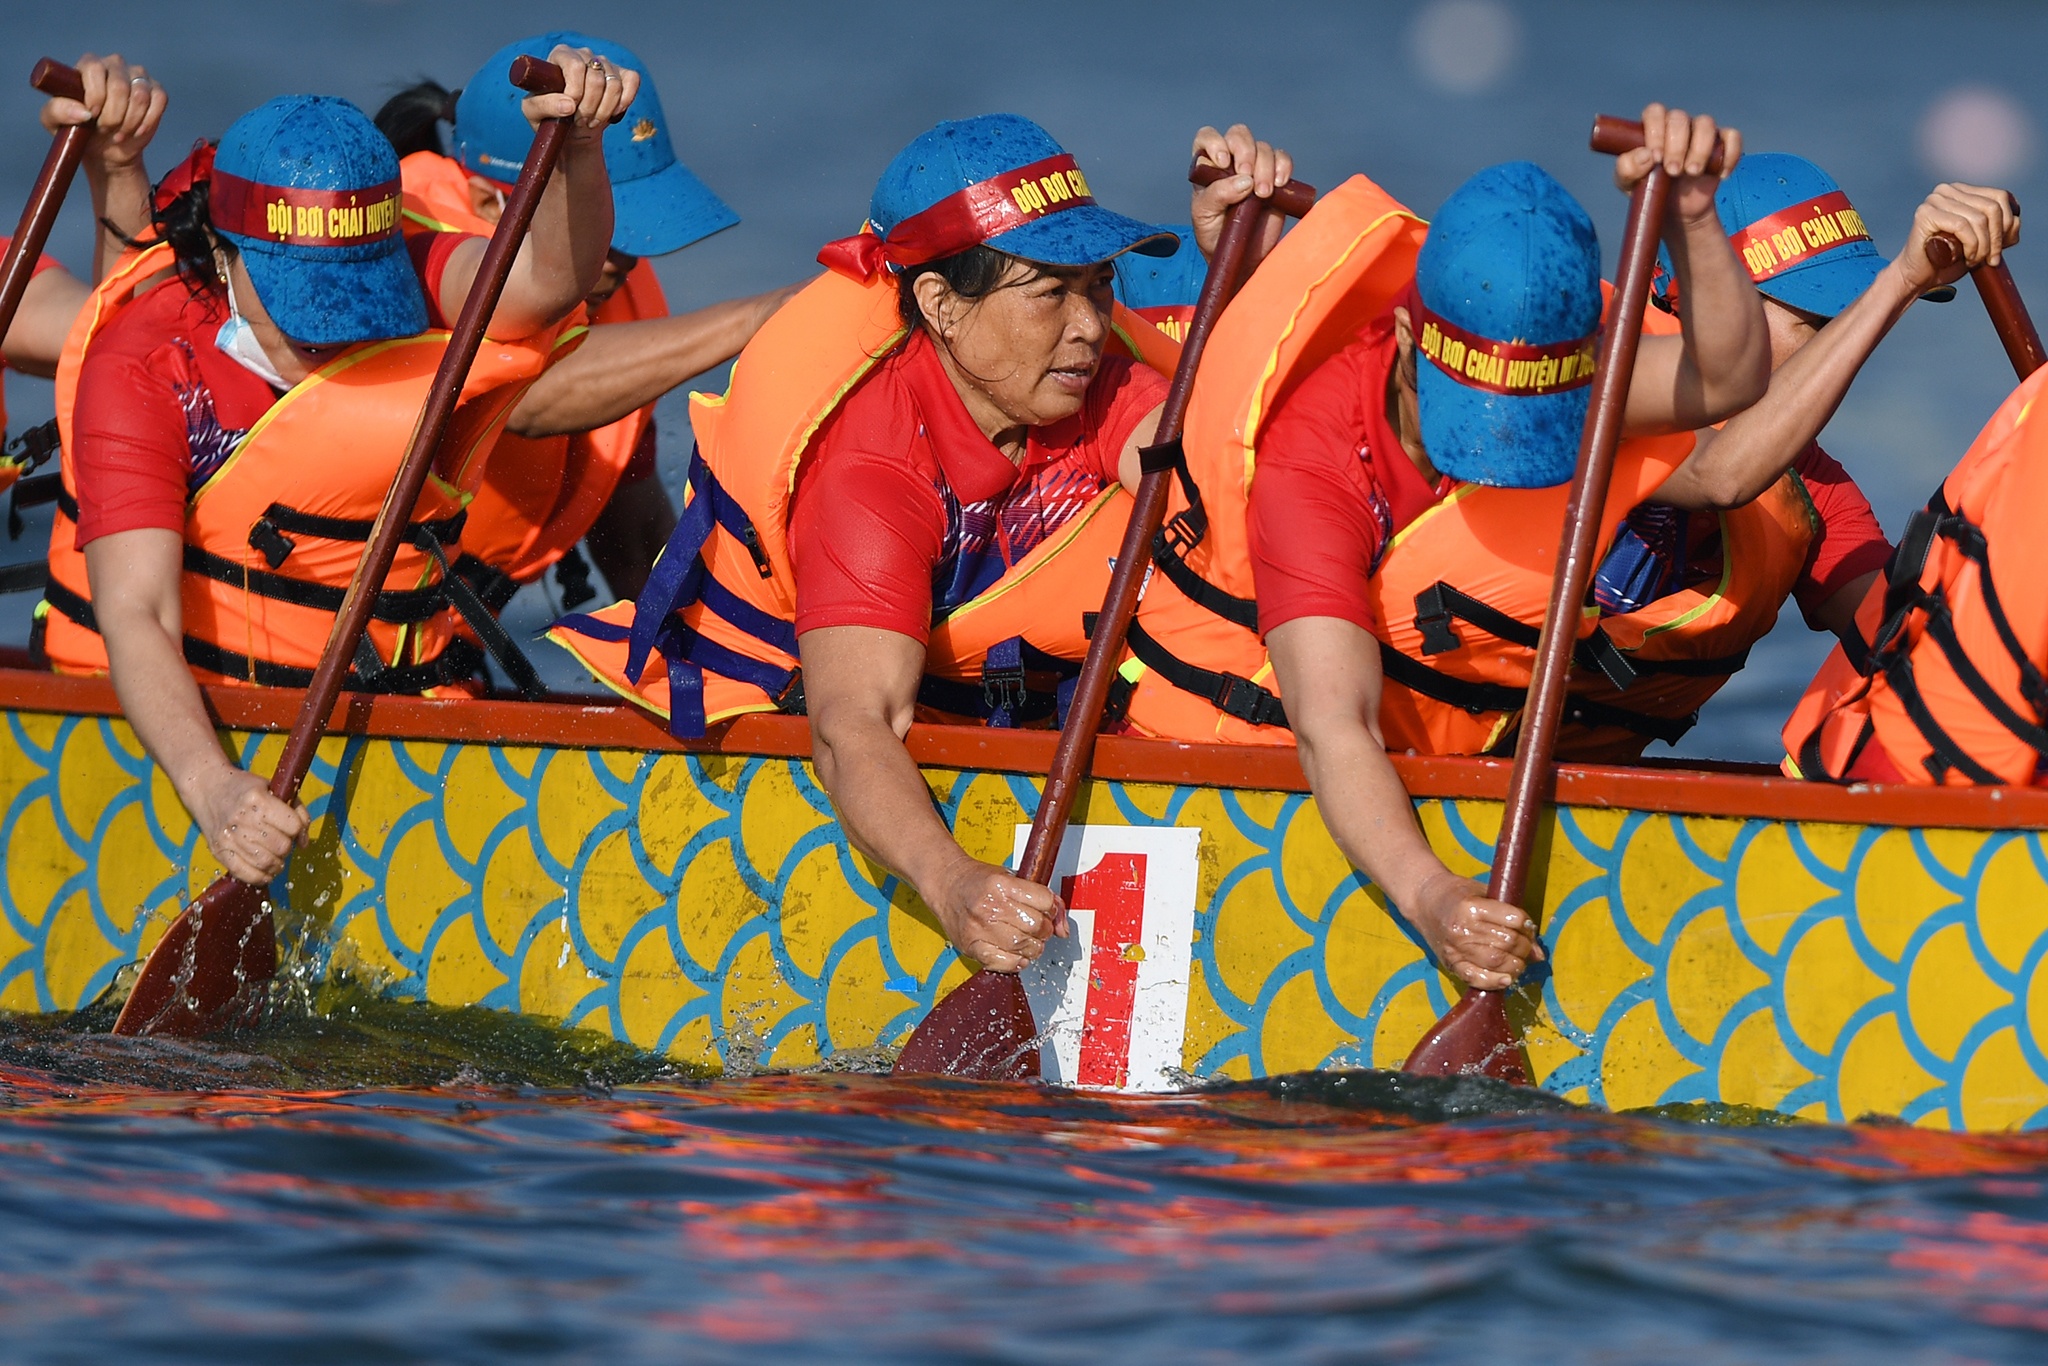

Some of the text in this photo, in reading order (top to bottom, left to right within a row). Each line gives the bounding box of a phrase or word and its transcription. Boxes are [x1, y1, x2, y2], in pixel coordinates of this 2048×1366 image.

[267, 198, 293, 241] ĐỘI
[296, 205, 324, 238] BƠI
[328, 195, 363, 238] CHẢI
[1011, 178, 1048, 214] ĐỘI
[1039, 171, 1073, 203] BƠI
[1743, 238, 1778, 275] ĐỘI
[1771, 226, 1807, 261] BƠI
[1801, 205, 1843, 248] CHẢI
[1421, 322, 1443, 360] ĐỘI
[1441, 336, 1467, 372] BƠI
[1465, 345, 1506, 385] CHẢI
[1505, 355, 1559, 393] HUYỆN
[1061, 852, 1147, 1087] 1
